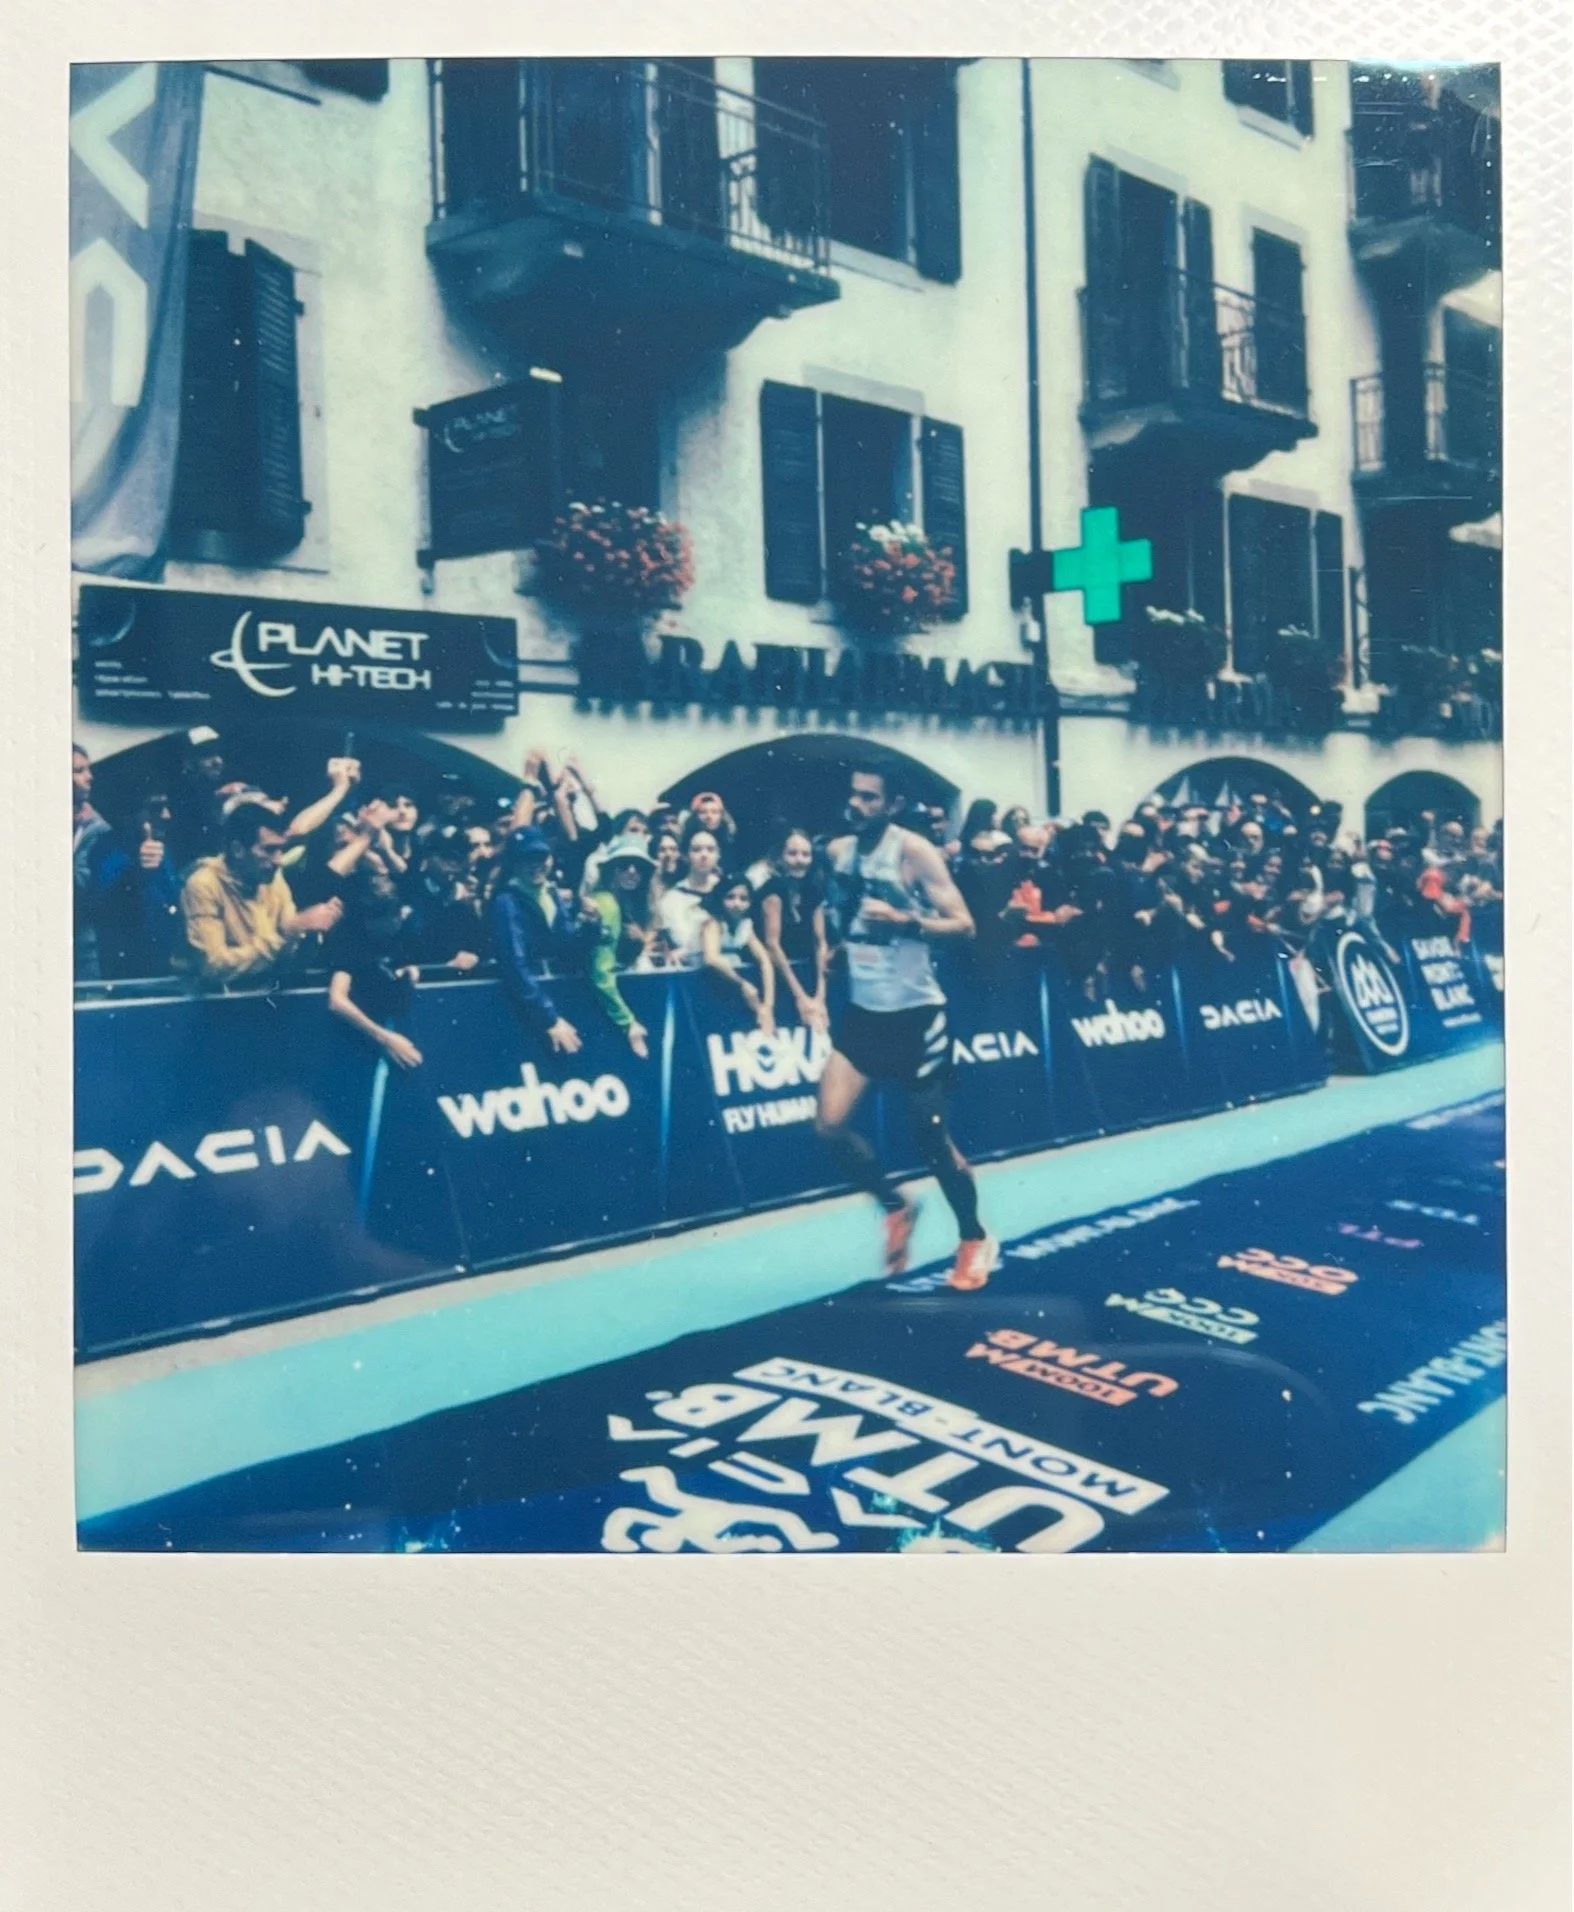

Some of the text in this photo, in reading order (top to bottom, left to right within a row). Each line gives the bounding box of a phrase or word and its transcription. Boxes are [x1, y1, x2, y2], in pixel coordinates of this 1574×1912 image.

[258, 621, 430, 660] PLANET
[311, 663, 431, 690] HI-TECH
[1071, 998, 1166, 1048] wahoo
[1199, 998, 1283, 1030] DACIA
[952, 1030, 1040, 1065] ACIA
[437, 1062, 630, 1139] wahoo
[73, 1119, 352, 1195] DACIA
[1234, 1247, 1359, 1283] OCC
[1144, 1288, 1260, 1326] CCC
[986, 1329, 1180, 1397] UTMB
[652, 1383, 1106, 1553] UTMB
